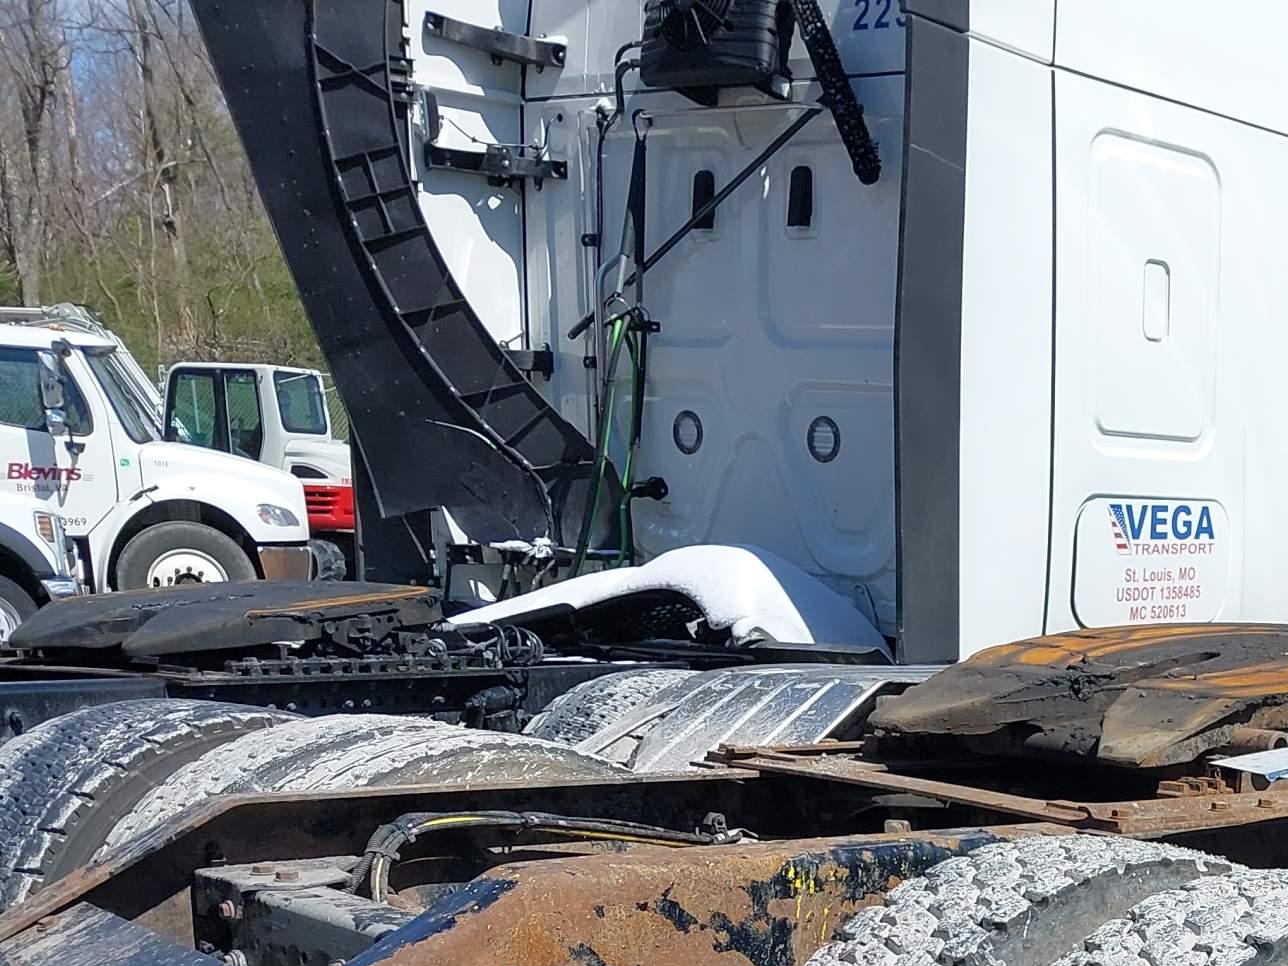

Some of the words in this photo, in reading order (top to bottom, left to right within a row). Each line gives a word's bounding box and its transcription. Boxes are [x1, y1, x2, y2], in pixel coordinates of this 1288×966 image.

[7, 463, 82, 481] Blevins
[1126, 504, 1215, 540] VEGA
[1134, 543, 1215, 555] TRANSPORT
[1124, 567, 1139, 582] St.
[1143, 568, 1175, 582] Louis,
[1179, 567, 1196, 581] MO
[1116, 587, 1156, 602] USDOT
[1160, 585, 1201, 600] 1358485
[1130, 606, 1147, 620] MC
[1150, 604, 1186, 619] 520613
